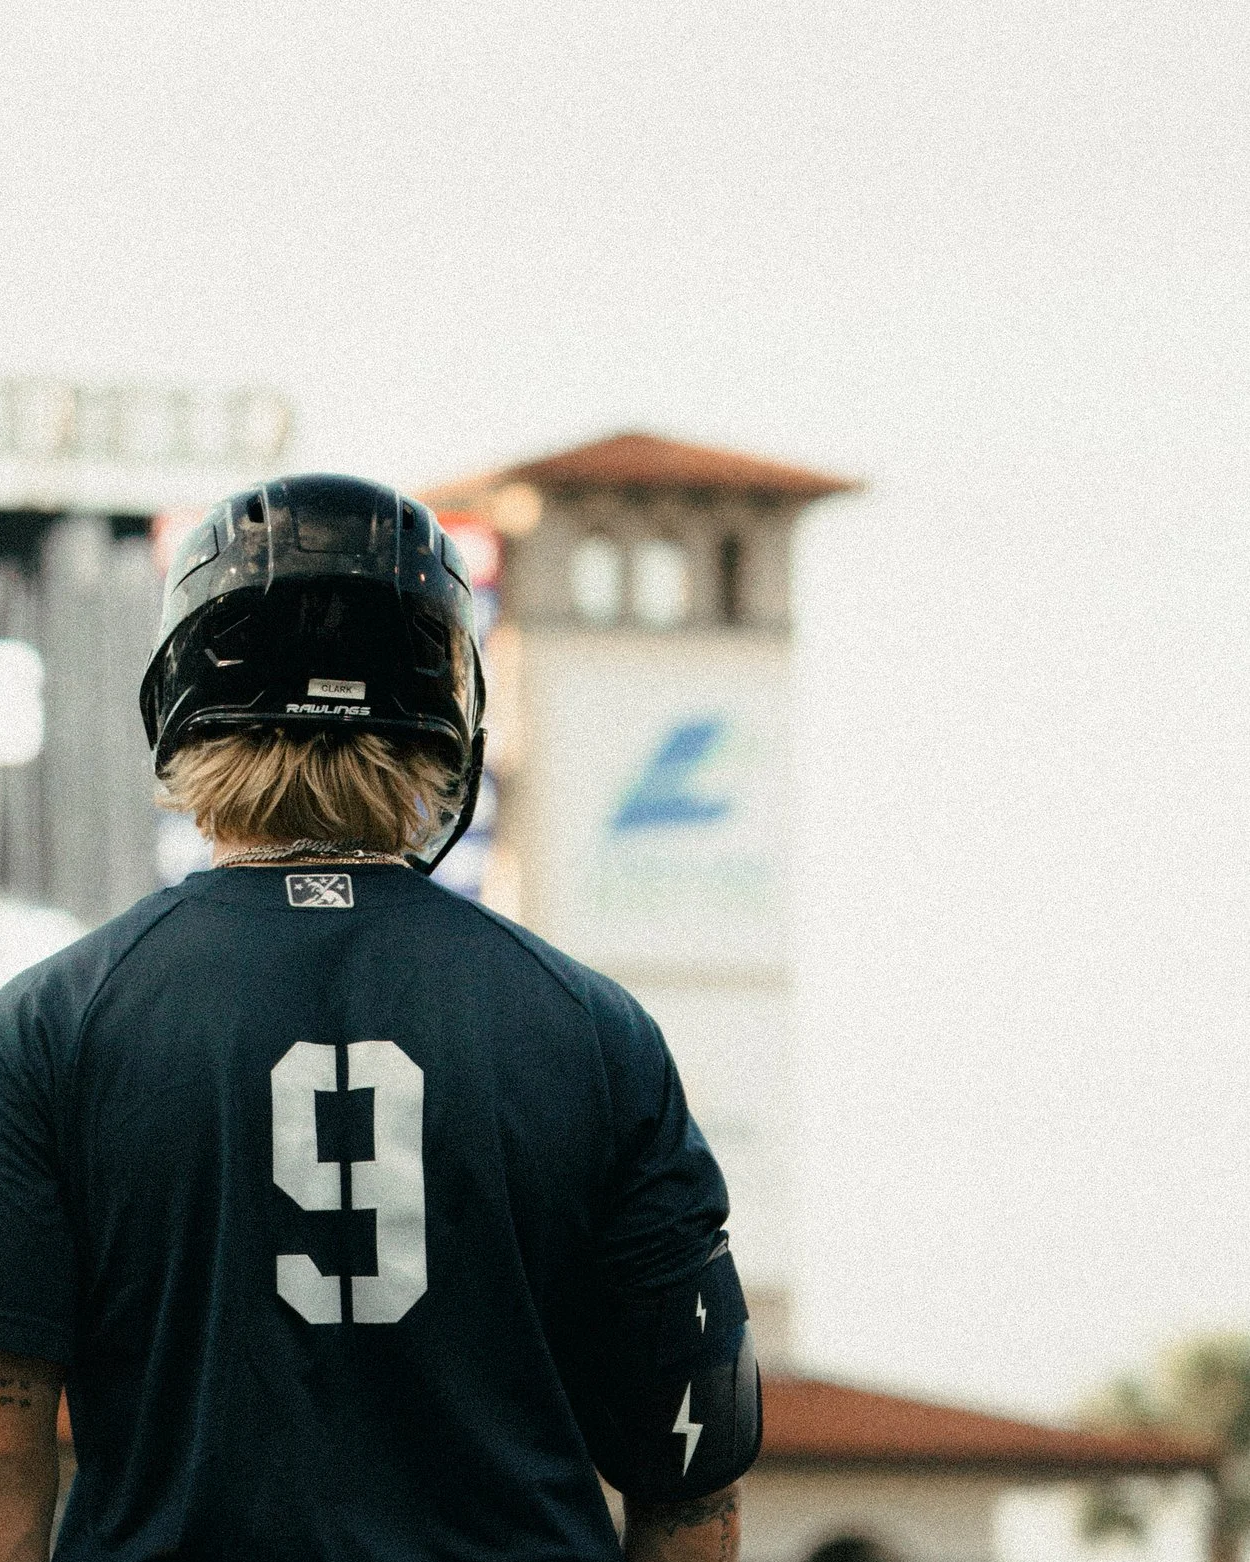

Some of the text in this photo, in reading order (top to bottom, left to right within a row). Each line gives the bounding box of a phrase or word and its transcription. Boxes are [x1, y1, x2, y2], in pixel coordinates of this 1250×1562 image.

[321, 684, 353, 694] CLARK
[285, 703, 372, 716] RAWLINGS
[270, 1040, 428, 1324] 9
